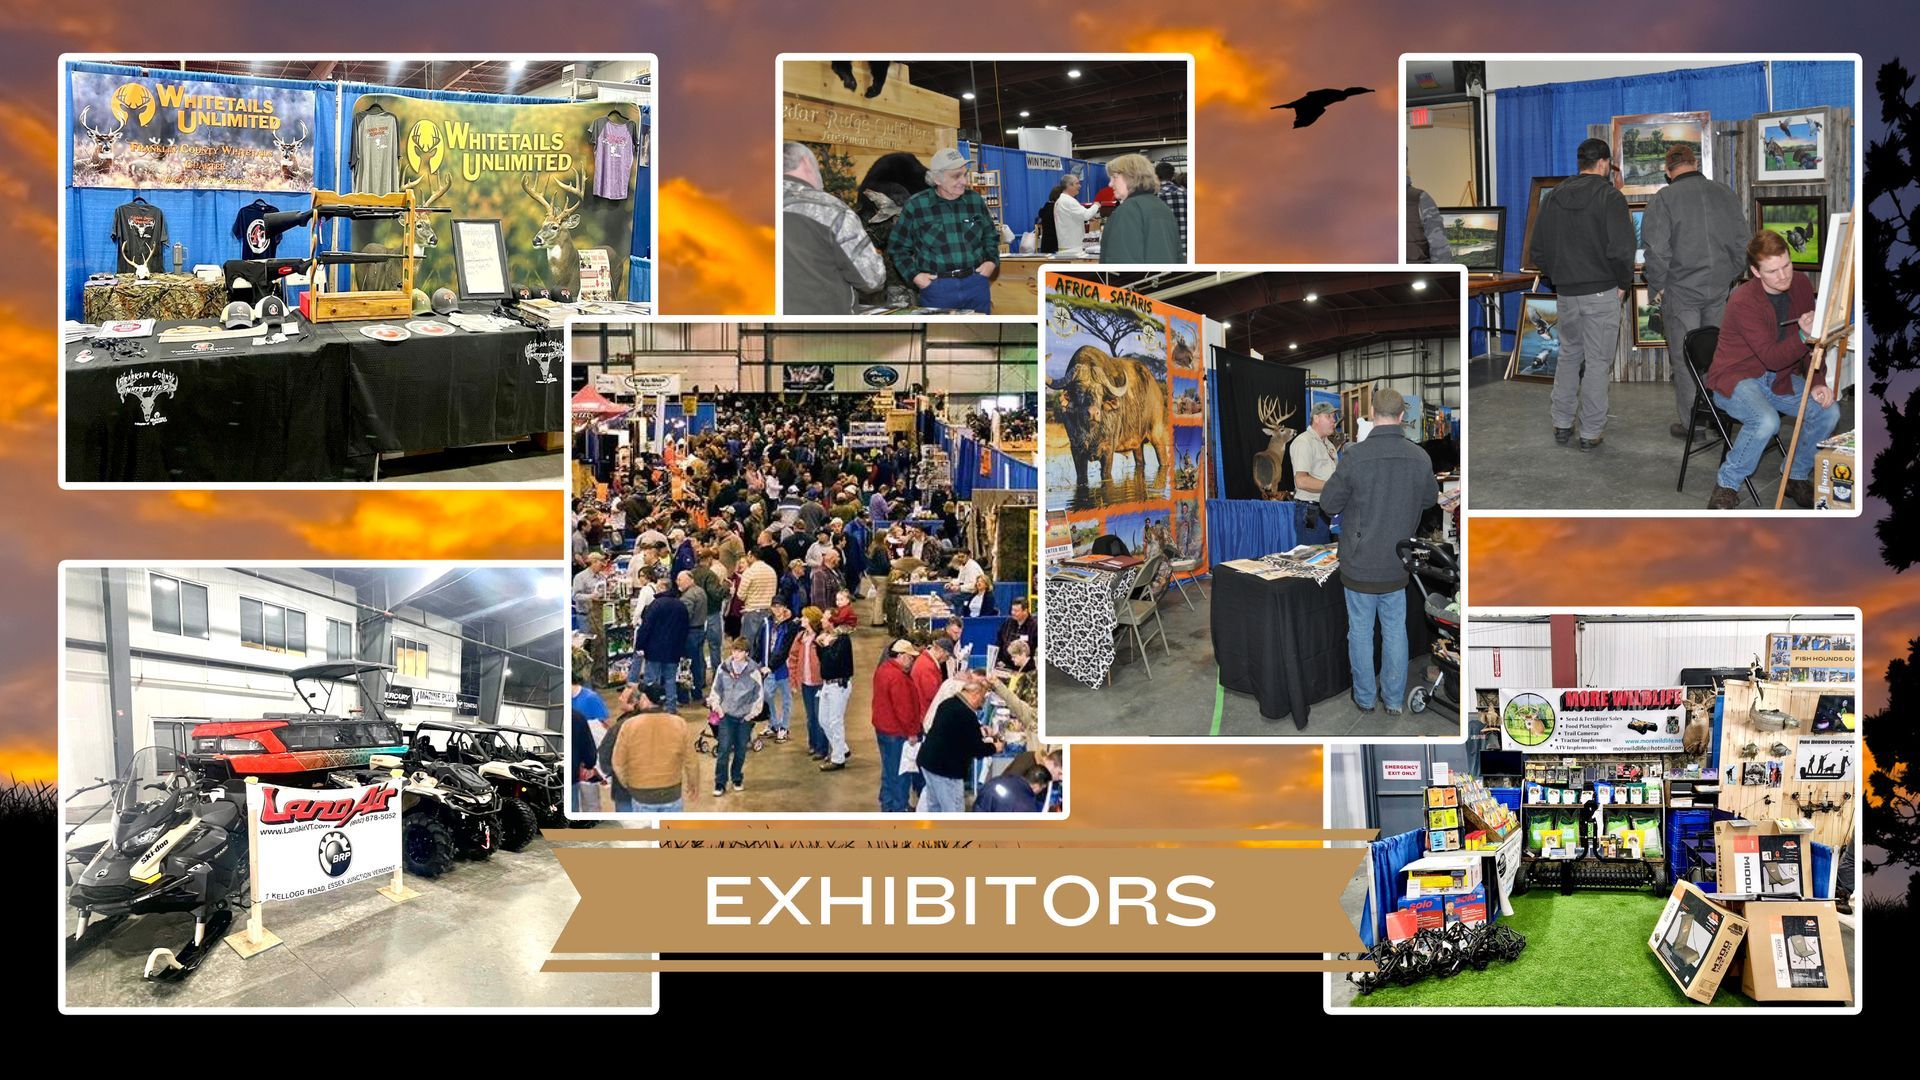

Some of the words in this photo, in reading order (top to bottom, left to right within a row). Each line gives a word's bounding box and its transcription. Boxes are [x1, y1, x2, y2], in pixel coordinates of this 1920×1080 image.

[156, 83, 273, 114] WHITETAILS
[177, 110, 281, 134] UNLIMITED
[826, 109, 870, 134] Ridge
[444, 120, 564, 151] WHITETAILS
[180, 144, 218, 156] COUNTY
[462, 152, 573, 182] UNLIMITED
[1055, 277, 1099, 302] AFRICA
[1110, 289, 1152, 314] SAFARIS
[1561, 690, 1612, 710] MORE
[1613, 688, 1684, 710] WILDLIFE
[365, 812, 397, 823] 878-5052
[141, 839, 169, 865] ski-doo
[332, 851, 351, 863] BRP
[271, 888, 305, 900] KELLOGG
[328, 879, 345, 890] ESSEX
[346, 871, 372, 884] JUNCTION
[372, 864, 396, 877] VERMONT
[1710, 940, 1730, 973] M300
